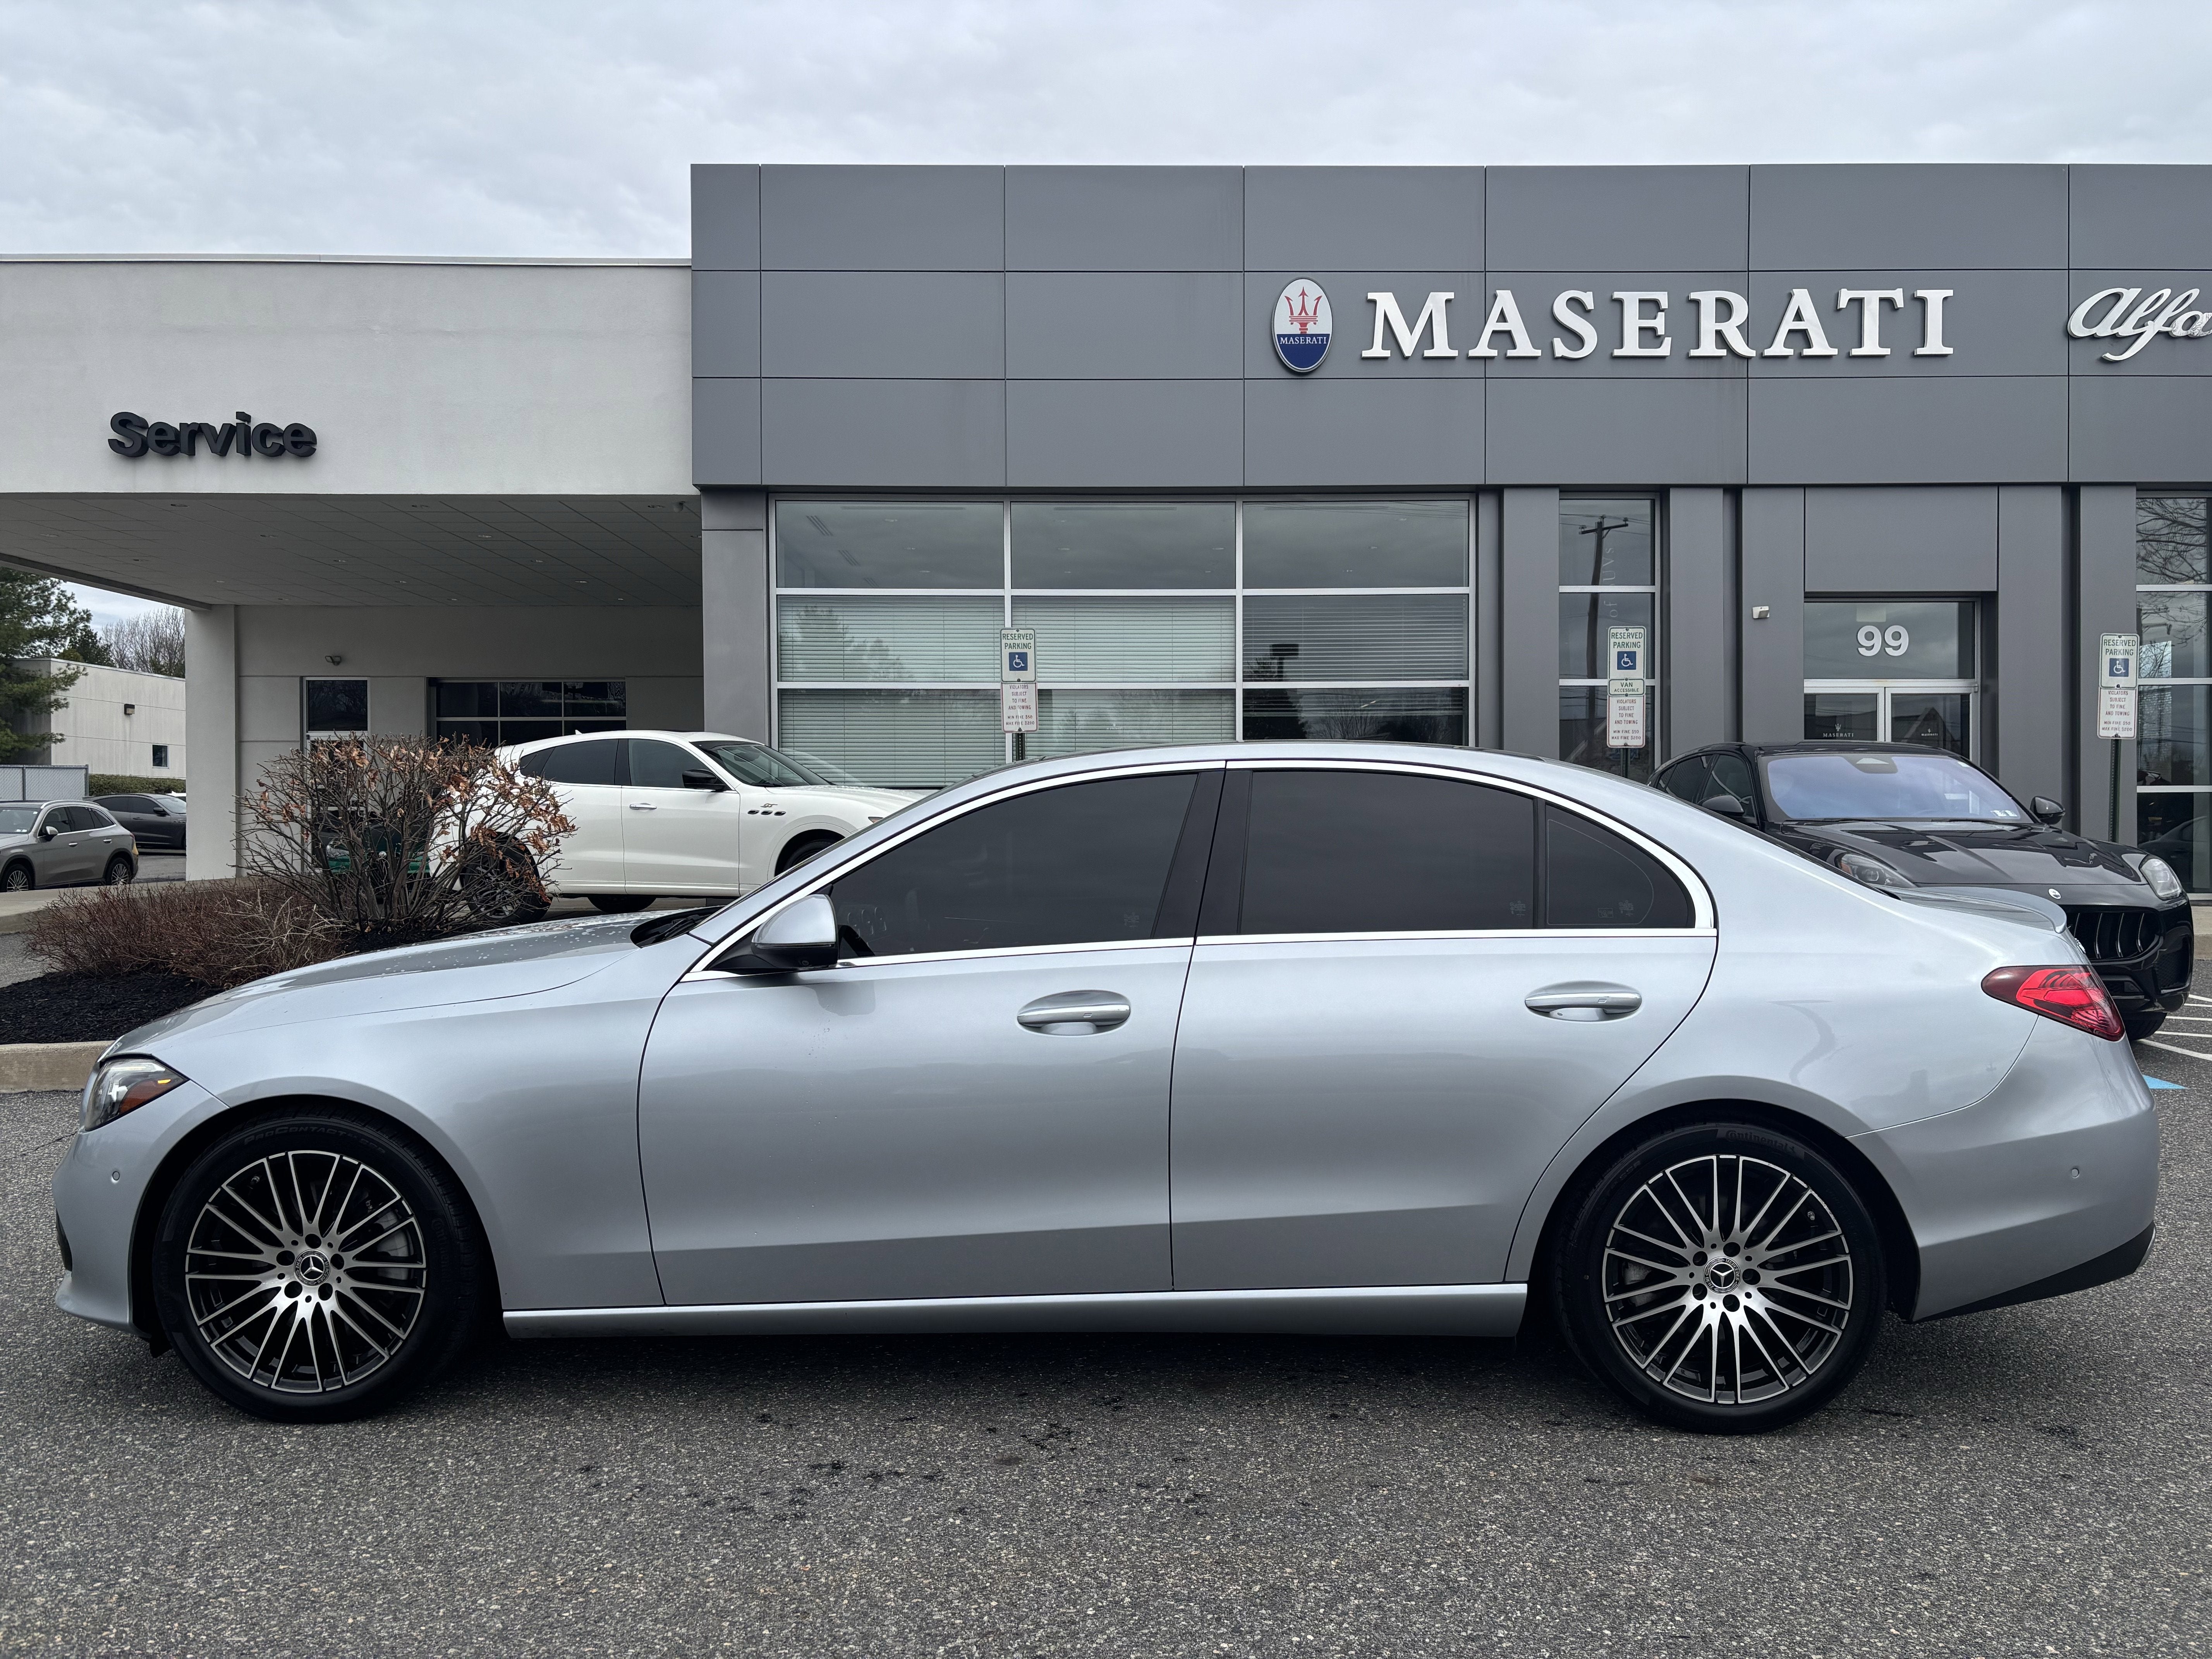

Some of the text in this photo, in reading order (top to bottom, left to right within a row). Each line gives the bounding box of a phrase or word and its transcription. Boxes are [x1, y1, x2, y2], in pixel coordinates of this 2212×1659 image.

[1361, 288, 1954, 361] MASERATI
[108, 411, 317, 457] Service
[1602, 548, 1616, 586] UVs
[1857, 625, 1909, 656] 99
